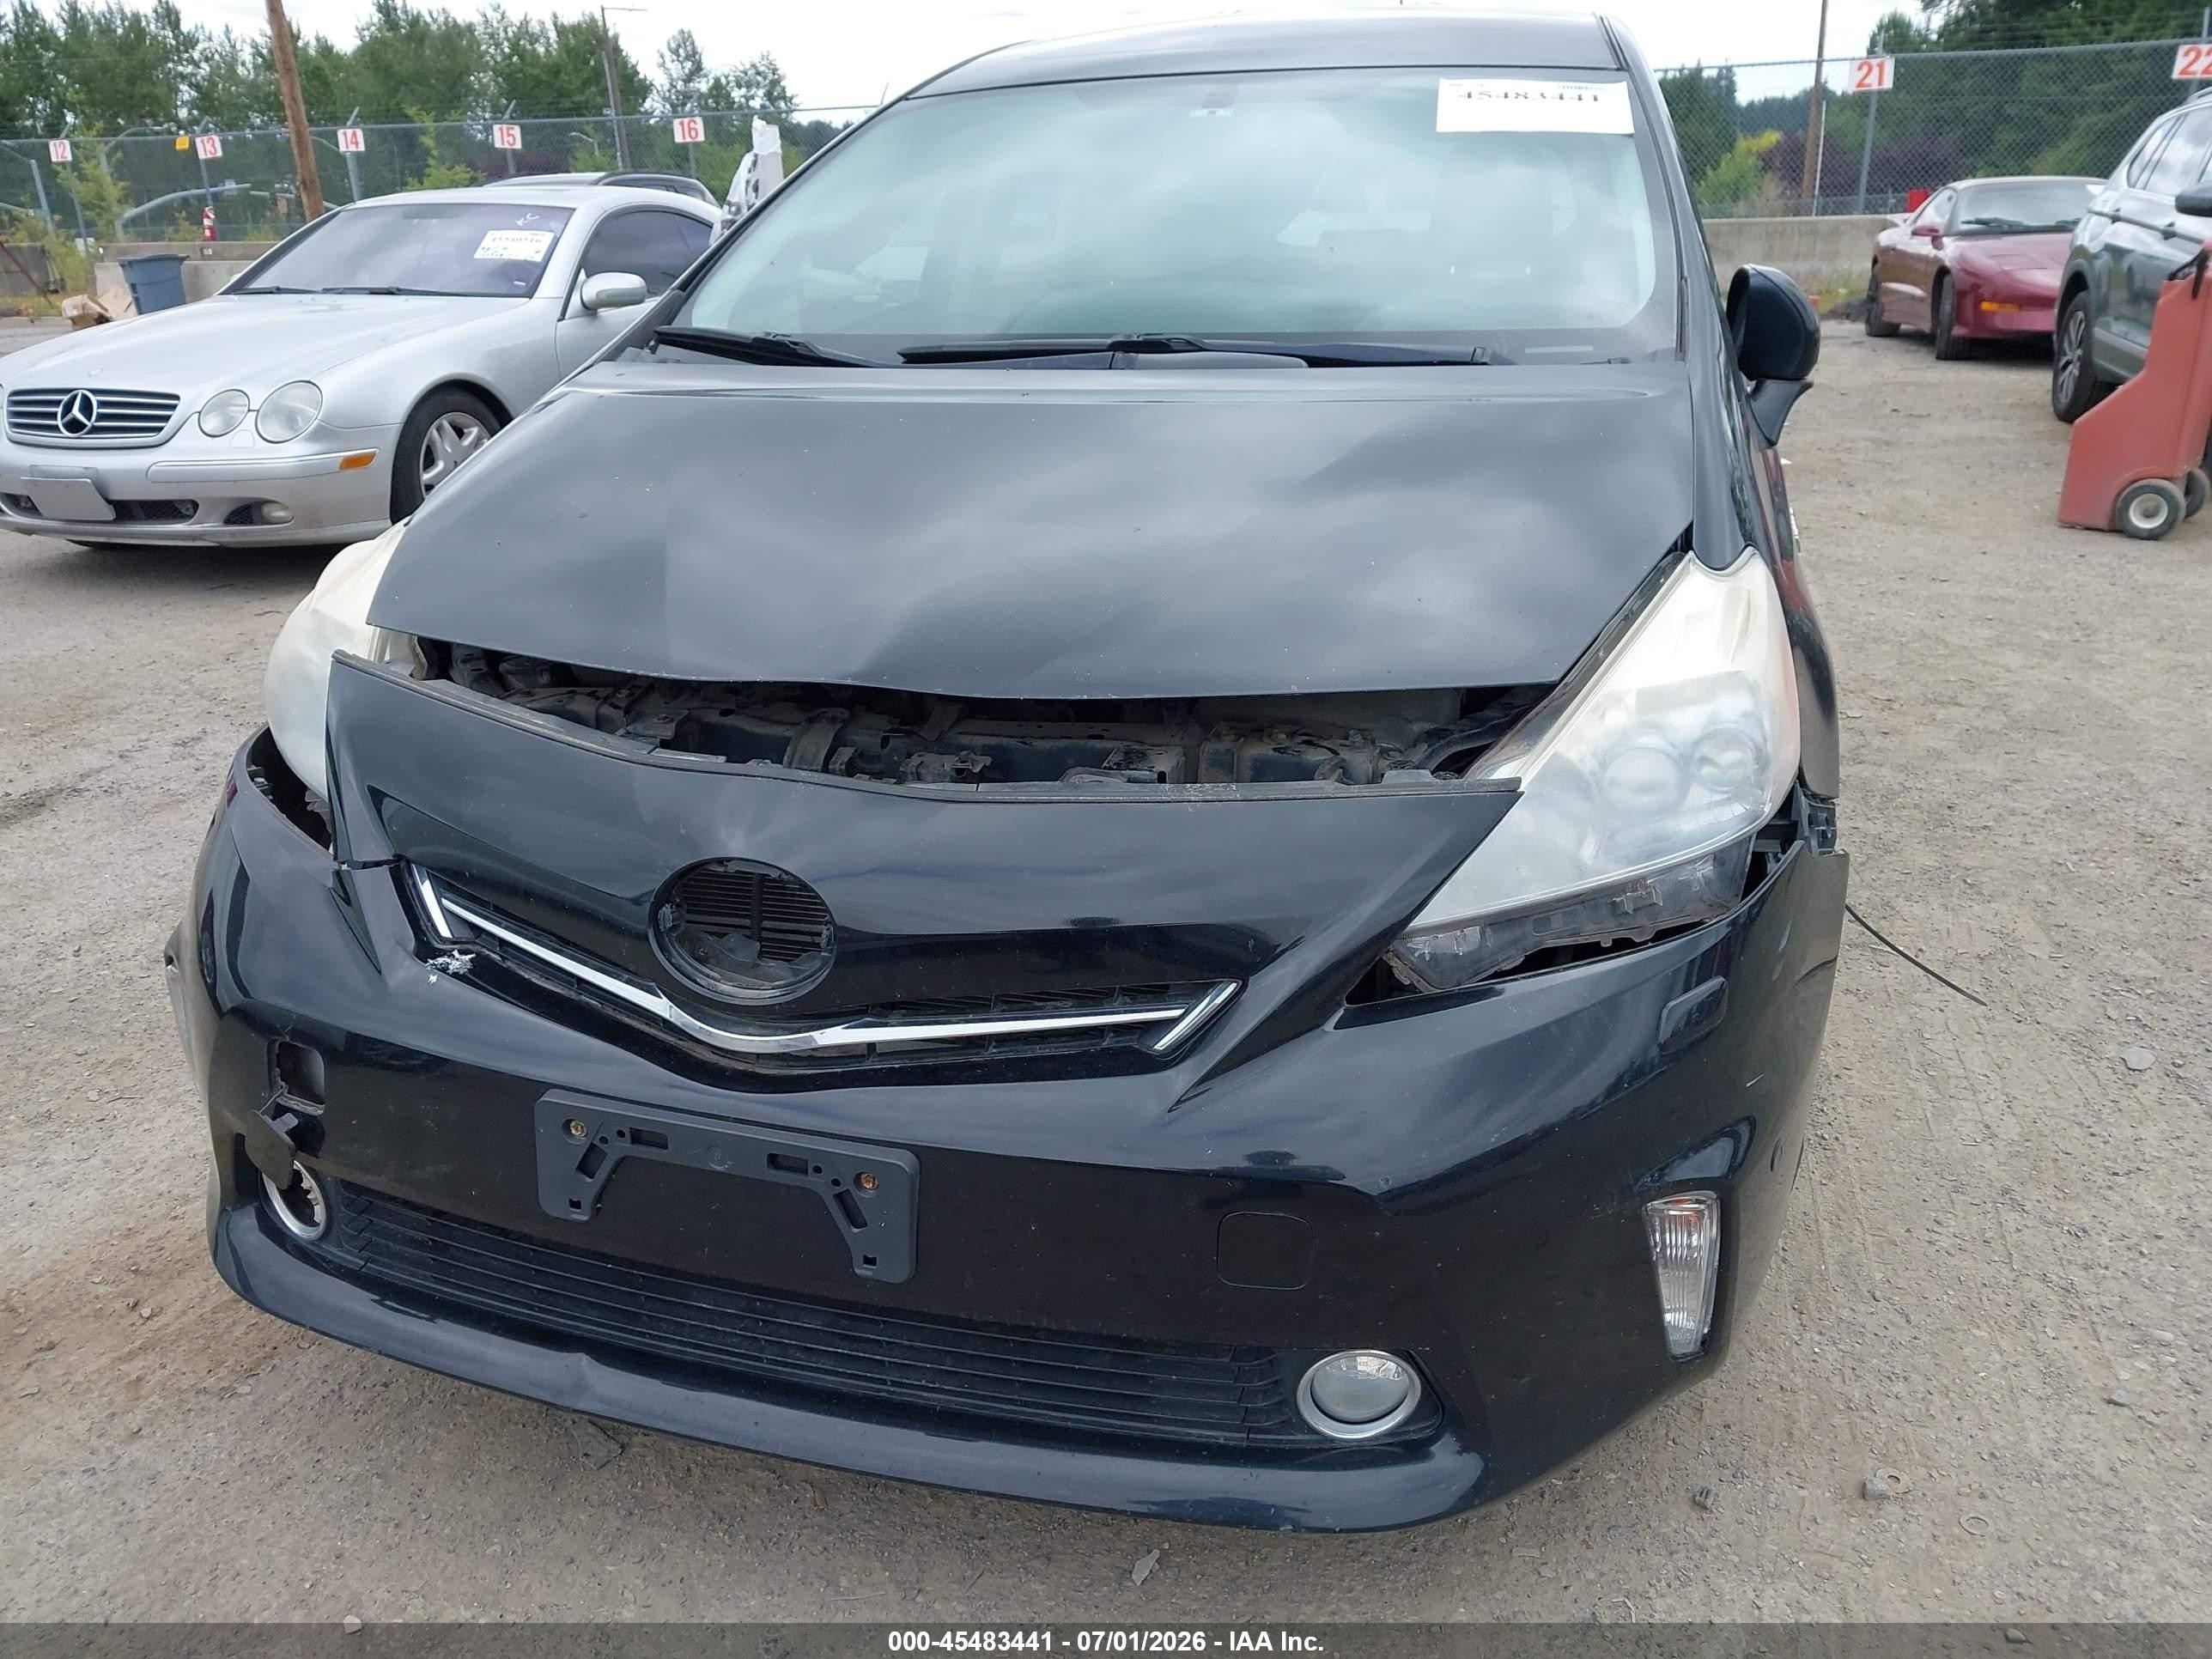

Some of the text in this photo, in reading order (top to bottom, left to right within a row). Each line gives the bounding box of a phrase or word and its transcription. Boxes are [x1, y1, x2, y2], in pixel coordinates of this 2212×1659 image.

[1856, 60, 1884, 88] 21
[343, 130, 359, 149] 14
[498, 125, 516, 147] 15
[678, 118, 699, 140] 16
[53, 140, 68, 161] 12
[200, 137, 218, 157] 13
